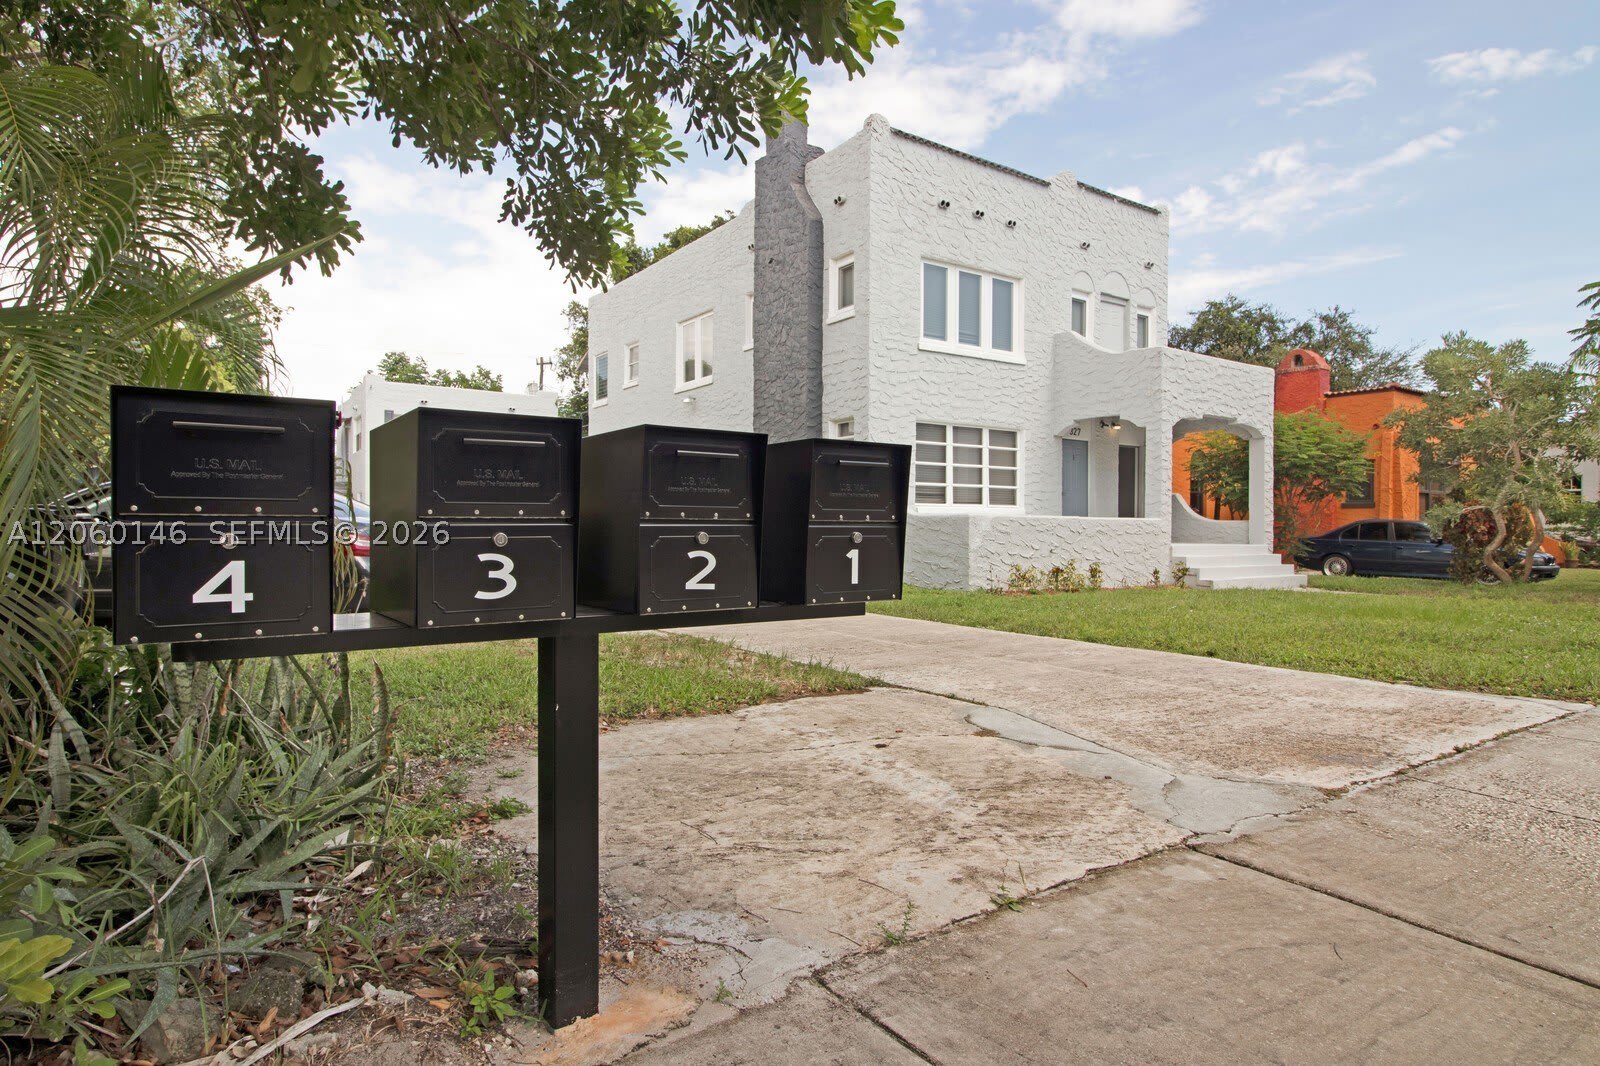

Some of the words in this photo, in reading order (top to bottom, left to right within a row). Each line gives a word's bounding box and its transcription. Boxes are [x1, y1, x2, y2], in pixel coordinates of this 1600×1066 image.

[170, 470, 201, 479] Approved
[202, 471, 211, 480] By
[211, 471, 225, 479] The
[259, 472, 284, 480] General
[194, 457, 223, 469] U.S.
[226, 458, 262, 471] MAIL
[472, 468, 496, 479] U.S.
[474, 552, 517, 600] 3
[685, 549, 717, 590] 2
[845, 548, 859, 585] 1
[192, 560, 254, 613] 4
